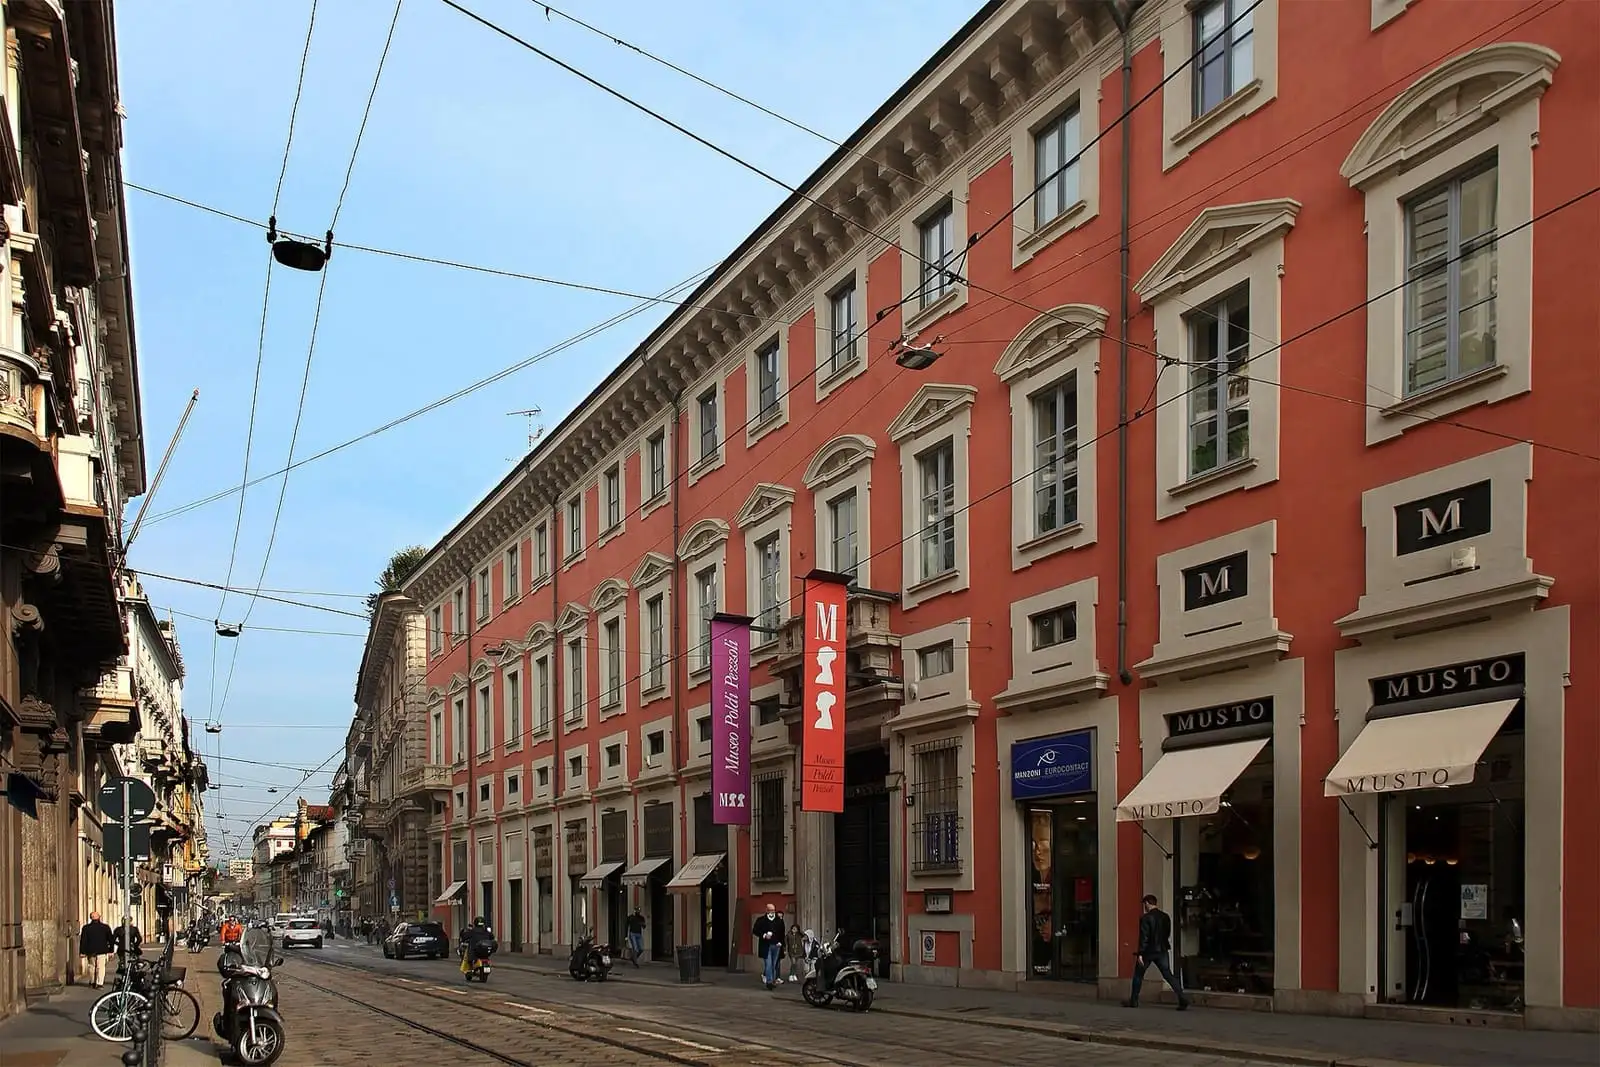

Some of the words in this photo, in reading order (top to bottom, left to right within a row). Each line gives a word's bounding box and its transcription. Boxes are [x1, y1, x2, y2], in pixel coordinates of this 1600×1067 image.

[1417, 497, 1465, 541] M
[1198, 564, 1232, 599] M
[814, 601, 840, 643] M
[724, 638, 740, 690] Pezzoli
[1386, 660, 1512, 700] MUSTO
[724, 691, 740, 729] Poldi
[1177, 701, 1265, 732] MUSTO
[724, 731, 740, 776] Museo
[1014, 768, 1041, 779] MANZONI
[1044, 762, 1089, 775] EUROCONTACT
[1345, 768, 1450, 794] MUSTO
[1132, 799, 1204, 819] MUSTO
